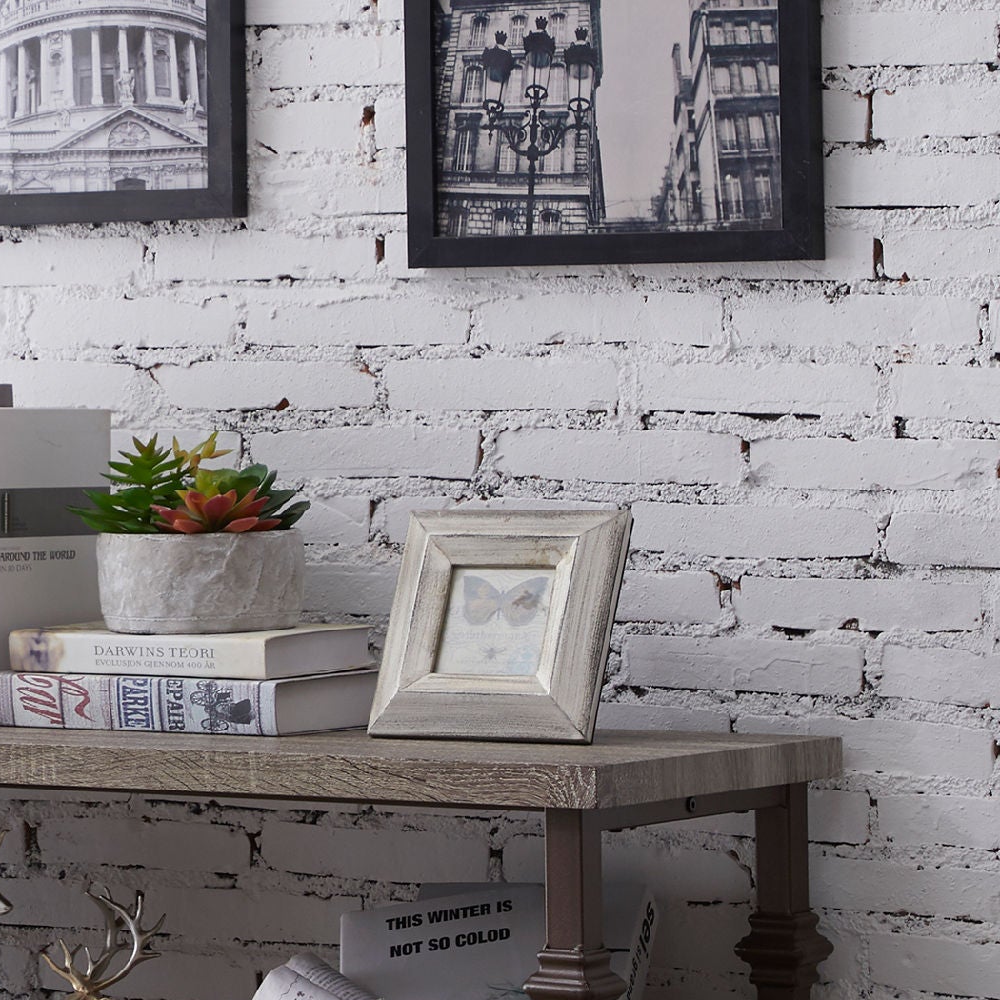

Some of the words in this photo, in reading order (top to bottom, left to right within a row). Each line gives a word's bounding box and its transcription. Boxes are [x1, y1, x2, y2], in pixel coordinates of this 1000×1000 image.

[0, 551, 31, 562] AROUND
[32, 550, 47, 561] THE
[49, 549, 76, 561] WORLD
[94, 645, 165, 658] DARWINS
[168, 647, 215, 659] TEORI
[144, 660, 185, 669] GJENNOM
[121, 677, 151, 729] PARKE
[385, 913, 423, 932] THIS
[427, 902, 491, 926] WINTER
[496, 899, 513, 913] IS
[389, 940, 424, 958] NOT
[428, 935, 451, 953] SO
[455, 927, 511, 948] COLOD
